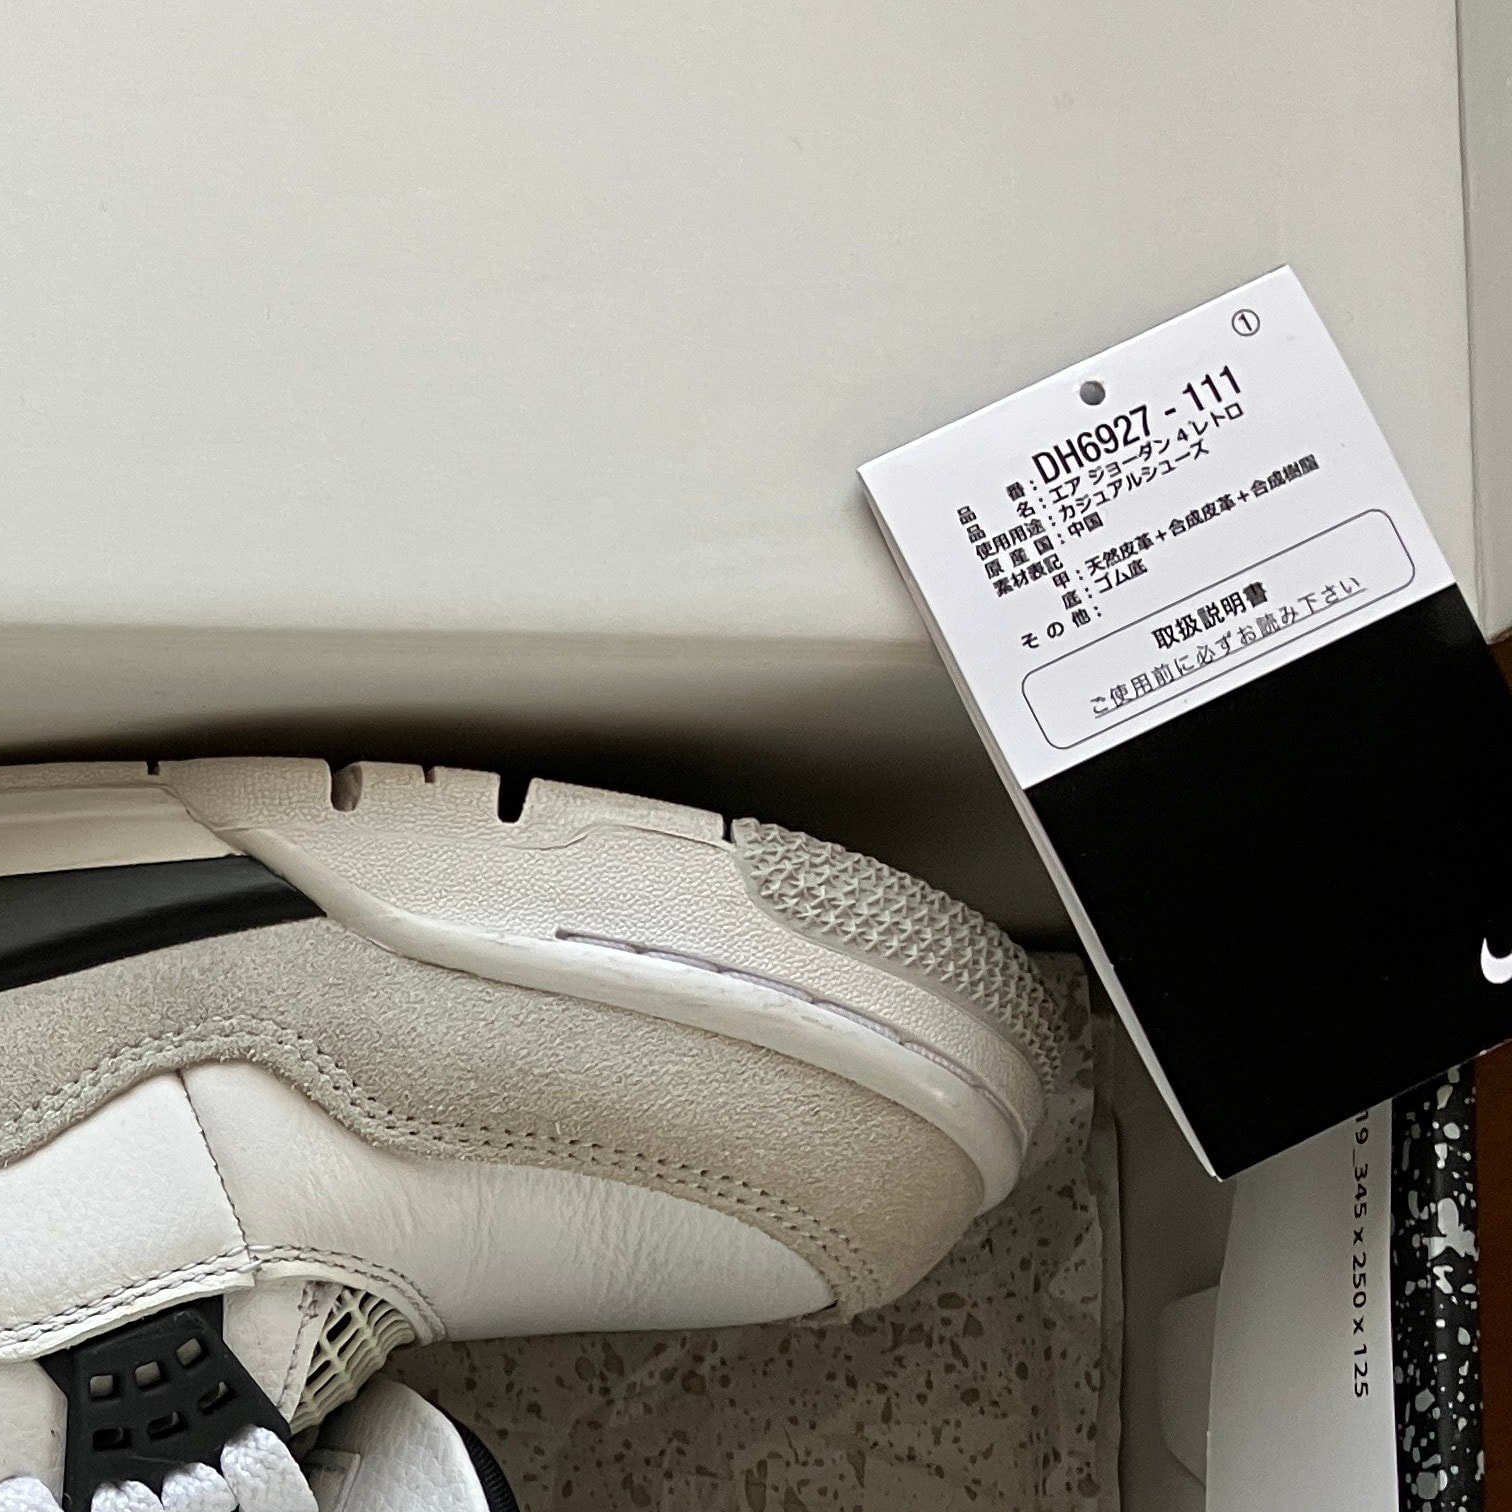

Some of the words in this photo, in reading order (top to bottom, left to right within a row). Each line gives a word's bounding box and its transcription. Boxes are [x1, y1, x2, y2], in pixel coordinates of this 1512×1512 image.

[1090, 577, 1360, 714] ご使用前に必ずお読み下さい
[1151, 581, 1268, 651] 取扱説明書
[1352, 1252, 1367, 1309] 250
[1353, 1344, 1369, 1398] 125
